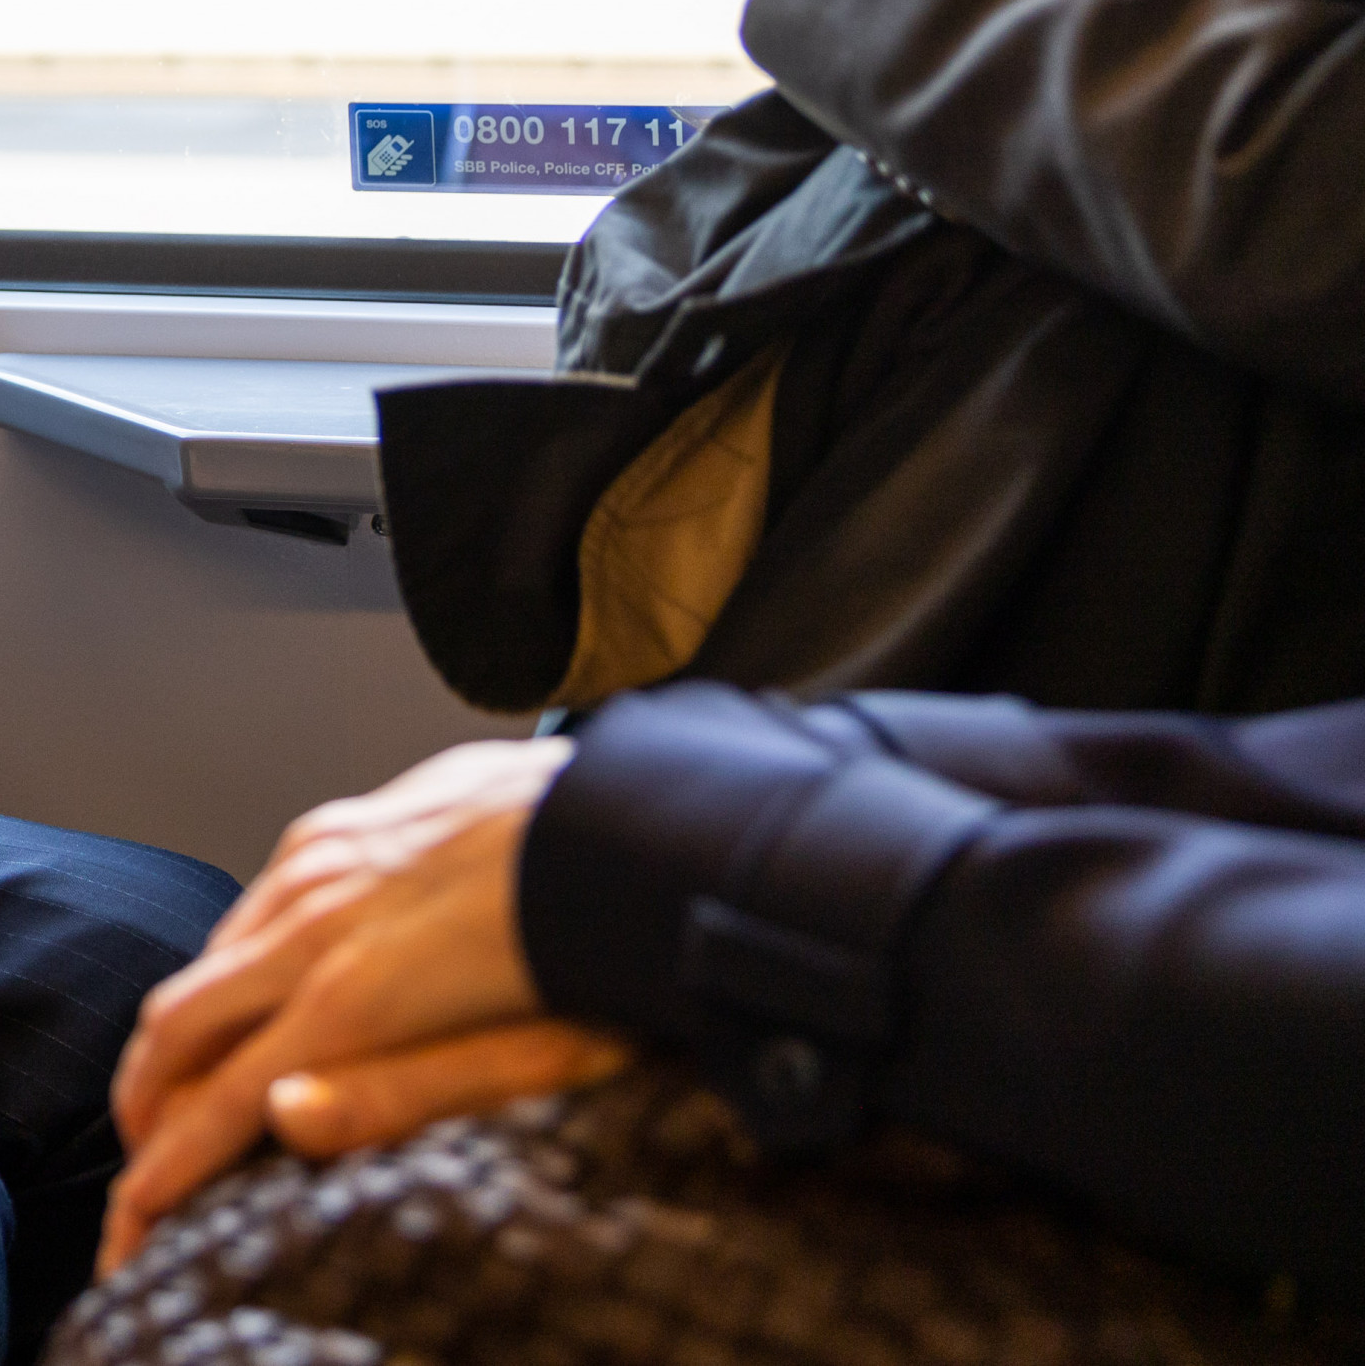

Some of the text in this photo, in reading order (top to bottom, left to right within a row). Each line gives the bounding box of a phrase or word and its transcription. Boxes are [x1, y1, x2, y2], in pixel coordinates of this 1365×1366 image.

[366, 119, 388, 129] SOS
[453, 115, 684, 147] 0800 117 11
[454, 160, 660, 178] SBB Police, Police CFF, Poli
